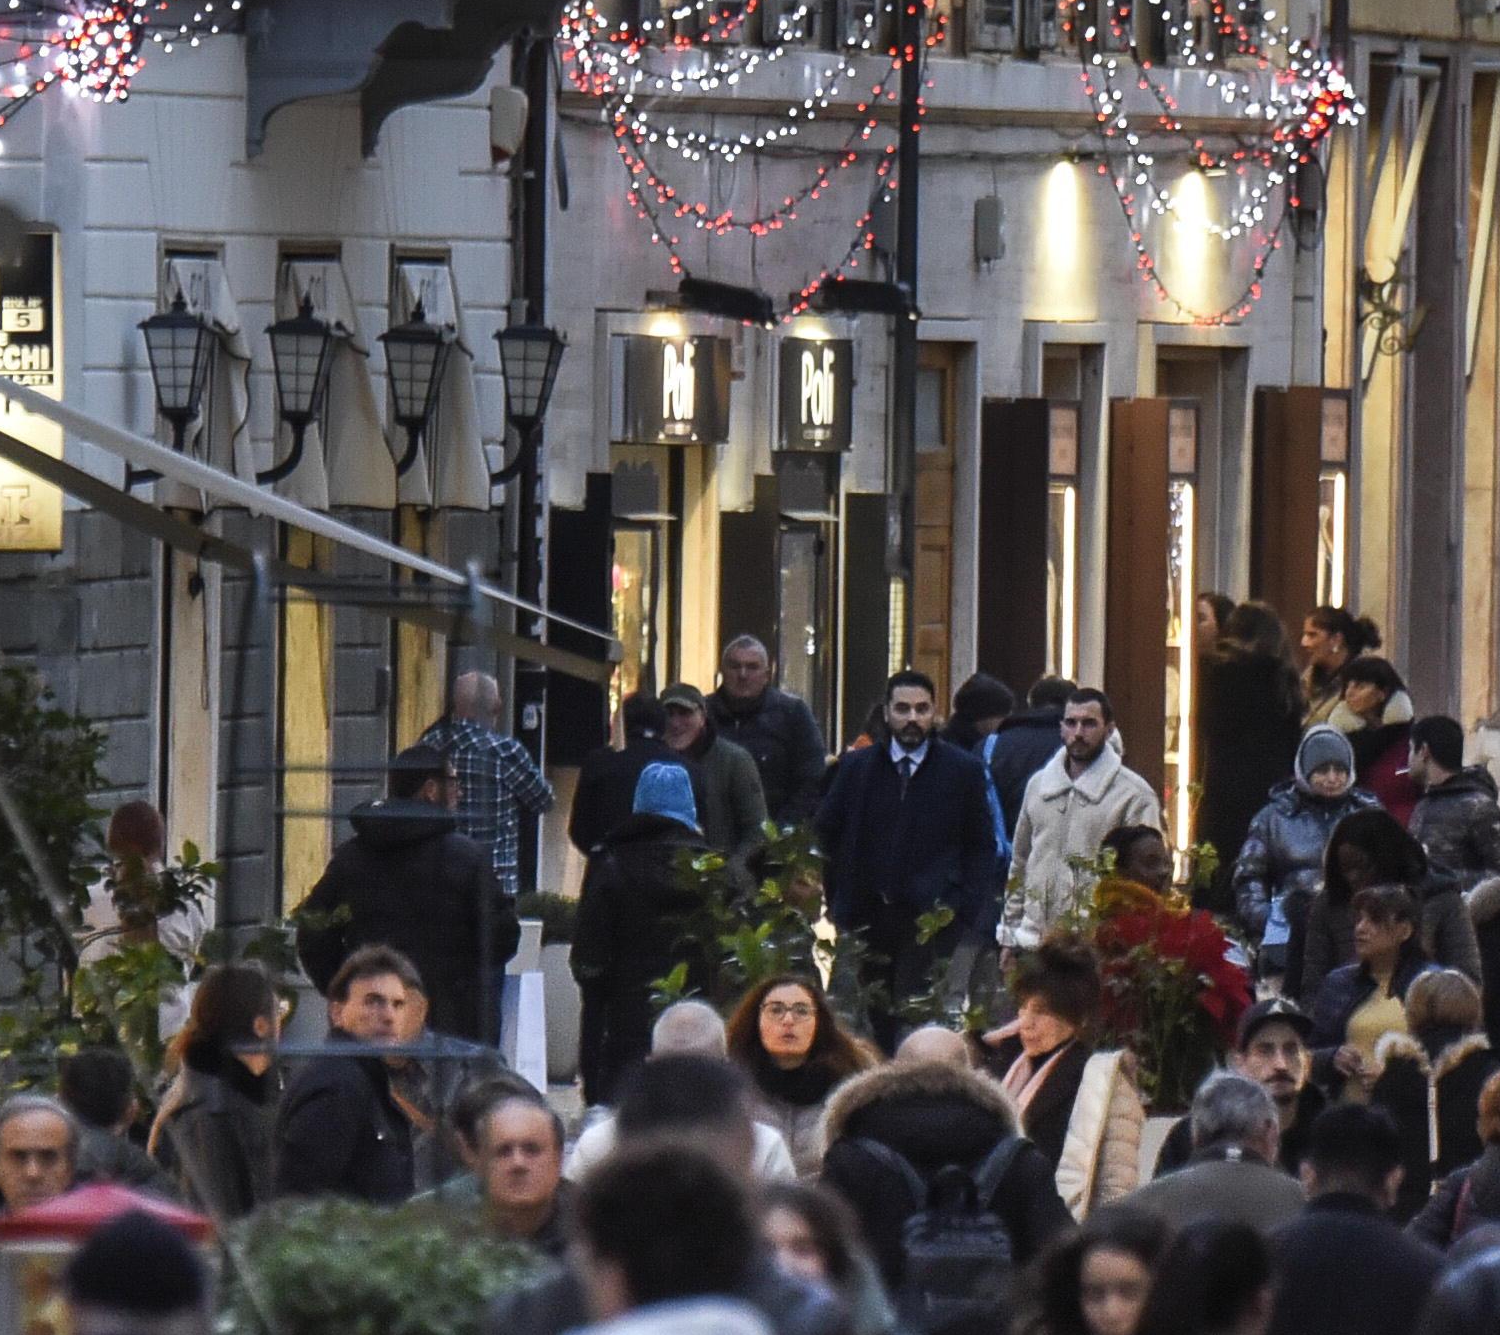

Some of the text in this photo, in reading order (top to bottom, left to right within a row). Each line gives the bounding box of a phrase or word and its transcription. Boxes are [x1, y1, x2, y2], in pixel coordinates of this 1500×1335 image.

[16, 312, 31, 328] 5
[663, 340, 695, 420] Poli
[801, 347, 835, 426] Poli
